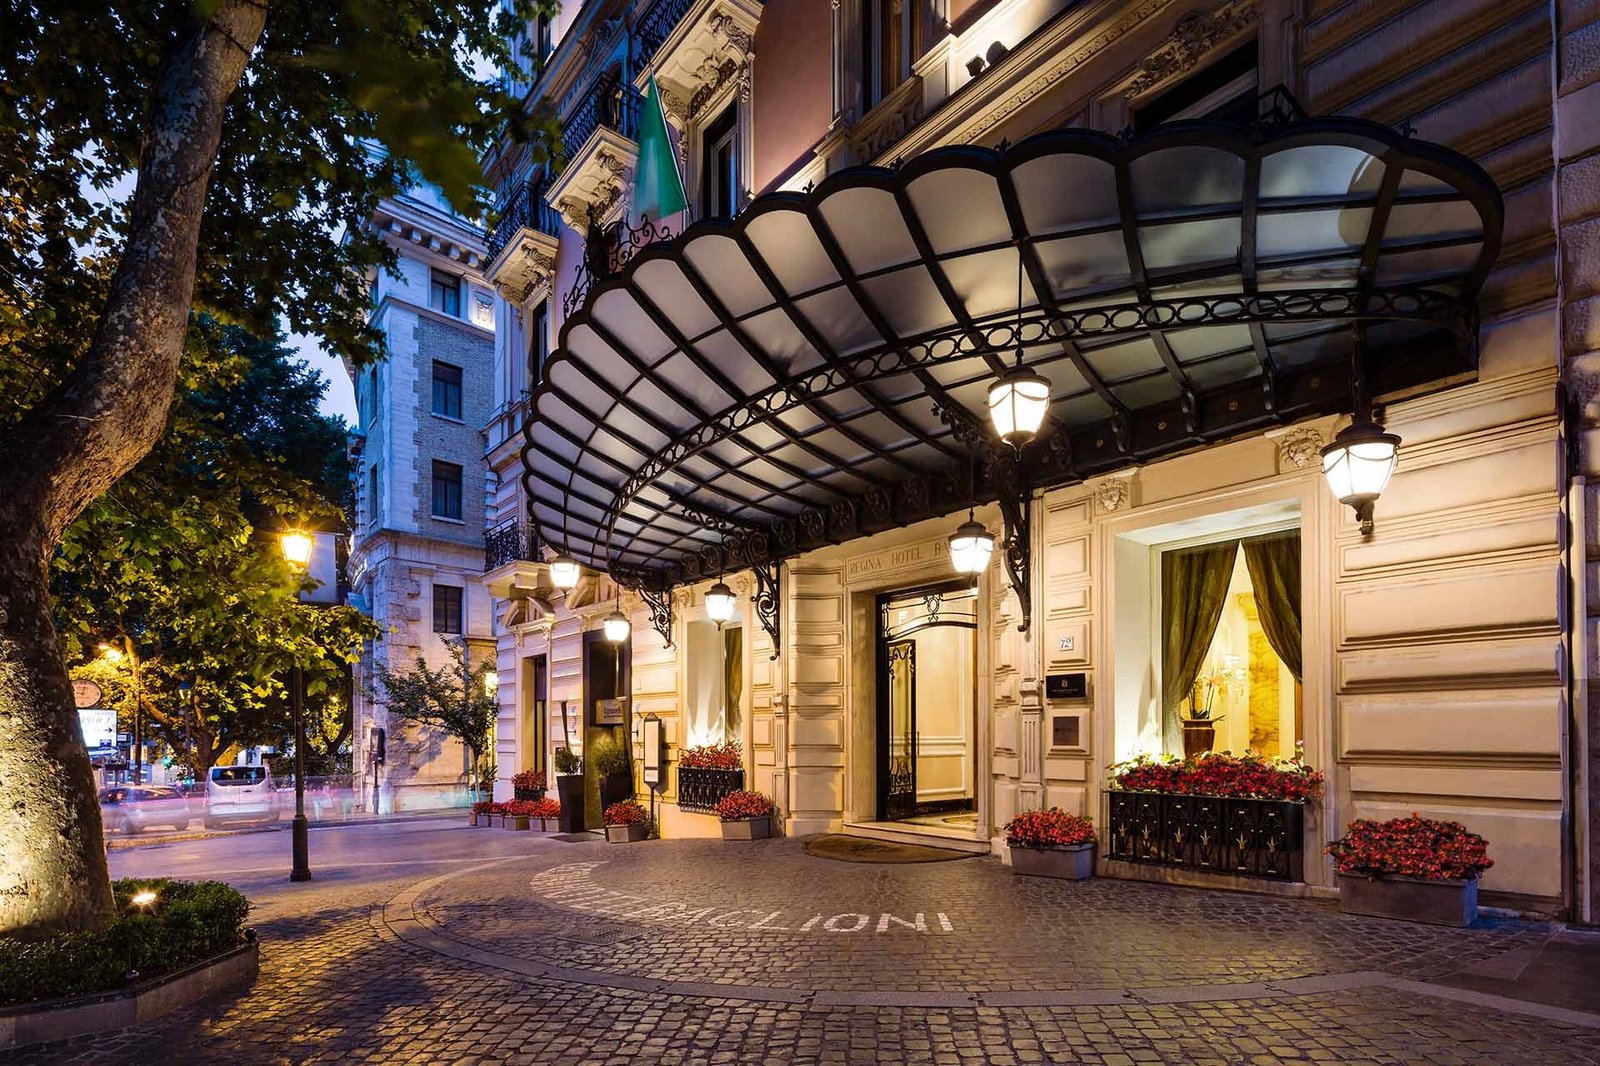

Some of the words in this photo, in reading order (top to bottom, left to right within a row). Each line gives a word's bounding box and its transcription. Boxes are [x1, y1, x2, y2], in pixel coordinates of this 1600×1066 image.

[850, 557, 882, 575] REGINA
[891, 546, 922, 565] HOTEL
[1060, 637, 1072, 649] 72
